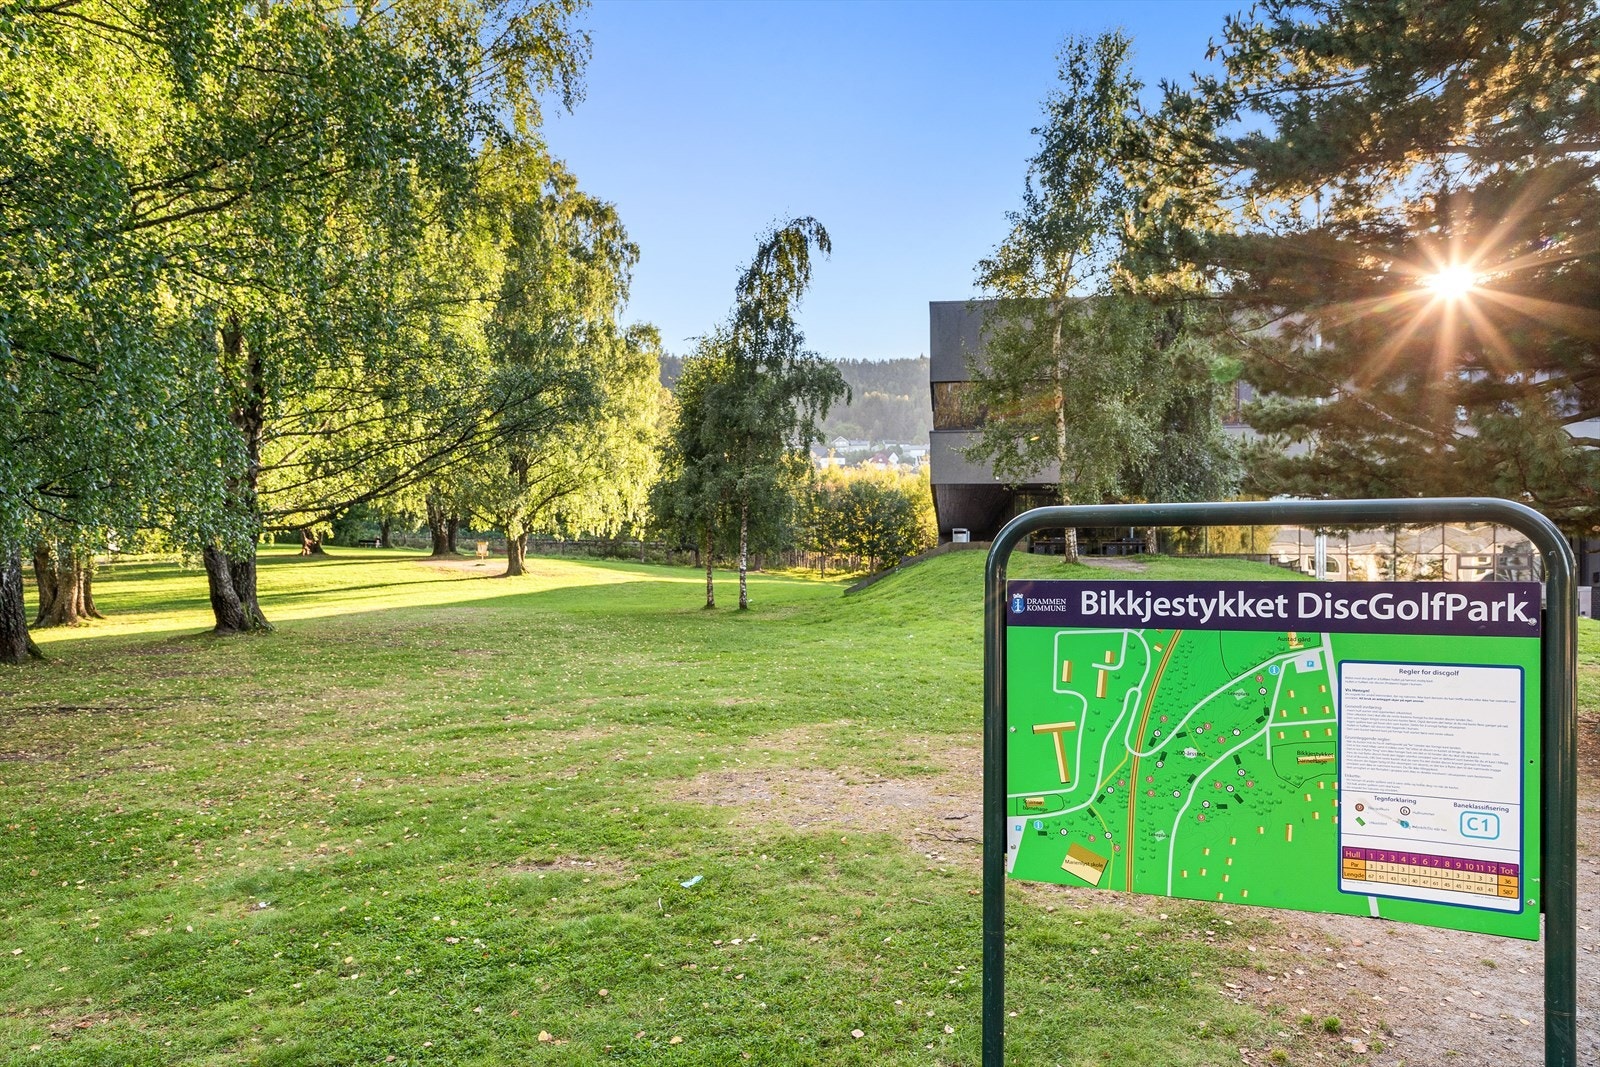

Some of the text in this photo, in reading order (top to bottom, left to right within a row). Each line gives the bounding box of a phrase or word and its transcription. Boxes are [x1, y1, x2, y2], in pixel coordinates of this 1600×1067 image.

[1081, 590, 1529, 623] Bikkjestykket DiscGolfPark
[1374, 796, 1416, 804] Tegnforklaring
[1454, 802, 1510, 813] Baneklassifisering
[1501, 867, 1514, 875] Tot
